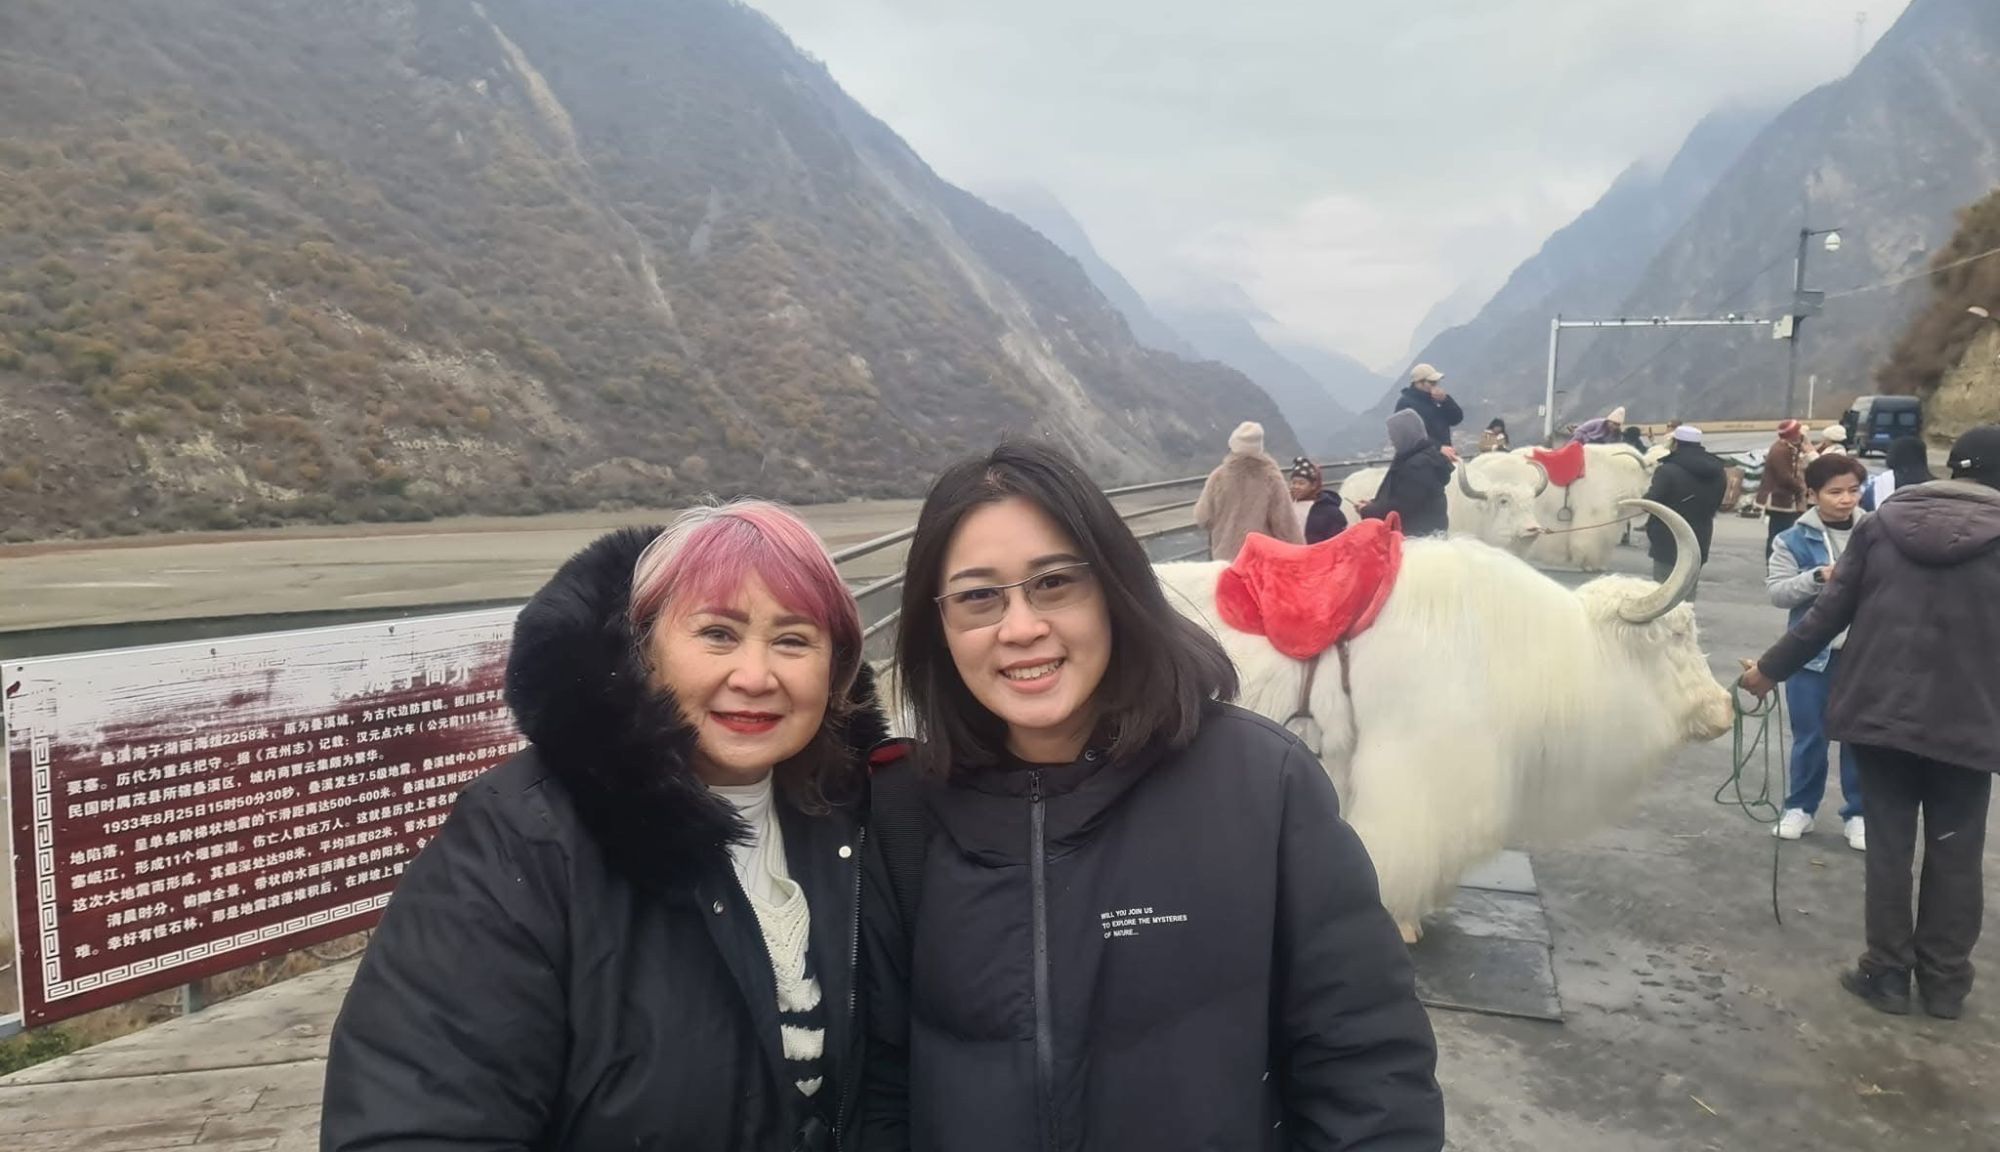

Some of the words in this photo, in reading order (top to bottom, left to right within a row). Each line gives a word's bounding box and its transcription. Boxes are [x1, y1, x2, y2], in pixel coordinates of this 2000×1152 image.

[1100, 911, 1114, 920] WILL
[1115, 909, 1127, 917] YOU
[1102, 921, 1111, 929] TO
[1111, 918, 1136, 928] EXPLORE
[1138, 917, 1151, 925] THE
[1152, 914, 1187, 924] MYSTERIES
[1103, 931, 1112, 939] OF
